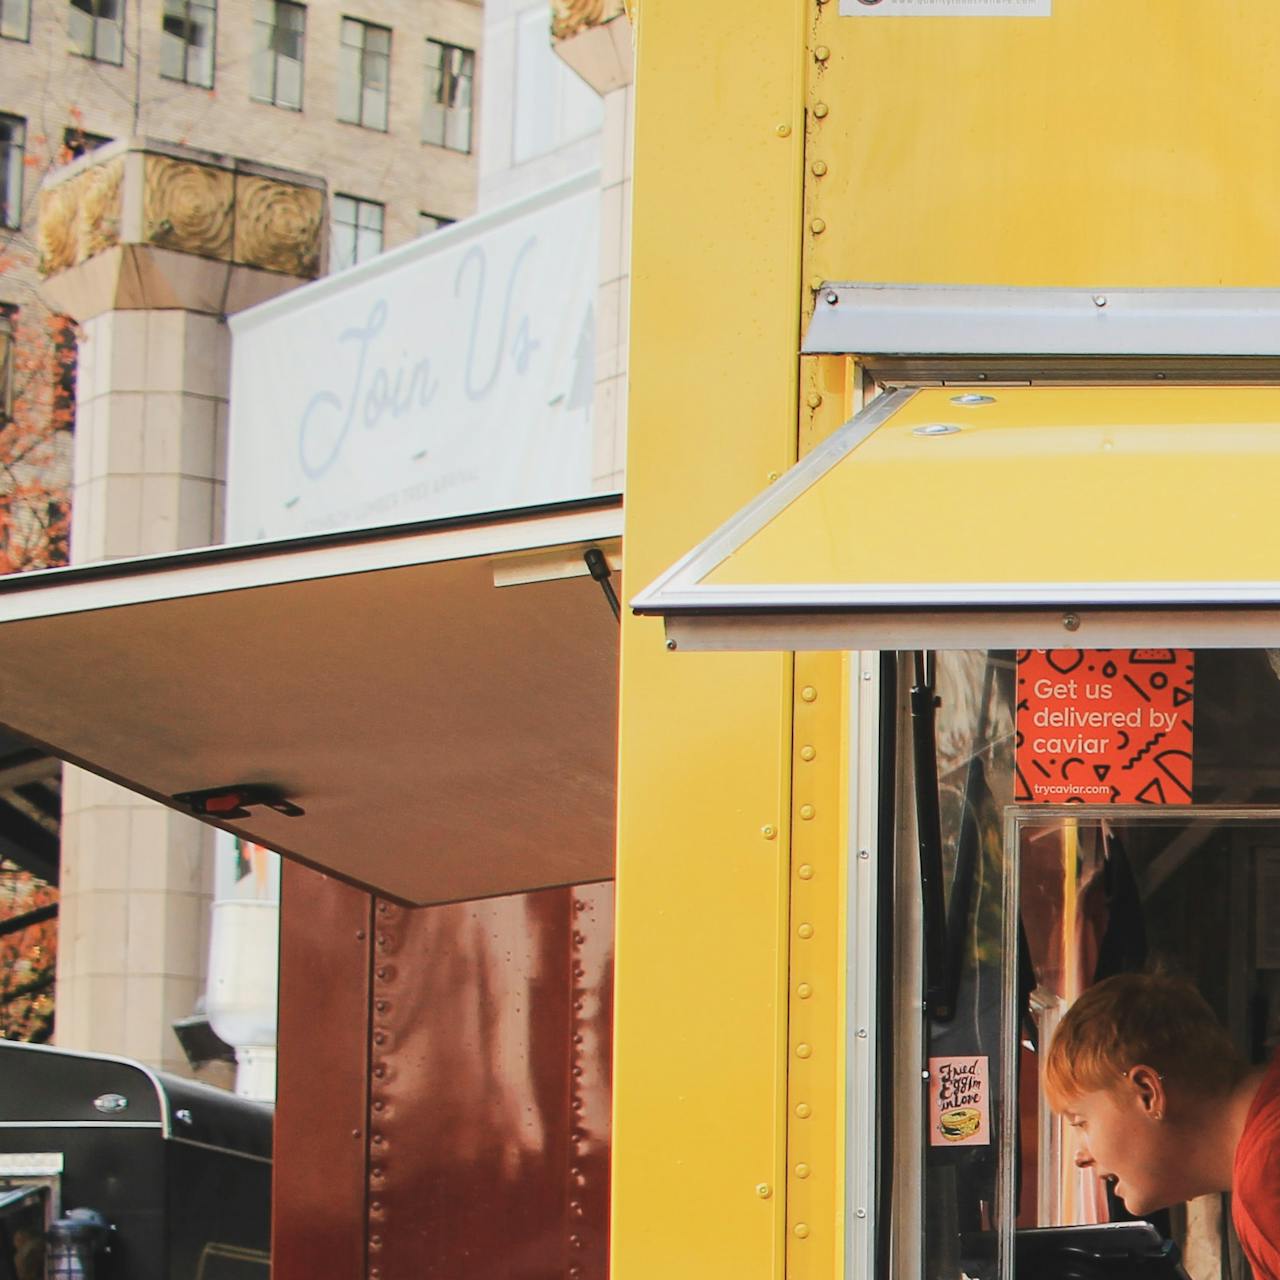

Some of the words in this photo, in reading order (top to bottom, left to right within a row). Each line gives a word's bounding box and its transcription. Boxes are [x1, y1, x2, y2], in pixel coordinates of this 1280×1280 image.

[298, 297, 439, 481] Join
[454, 233, 541, 403] Us
[1034, 679, 1077, 699] Get
[1085, 683, 1113, 699] us
[1033, 707, 1142, 728] delivered
[1150, 707, 1178, 732] by
[1033, 734, 1109, 754] caviar
[1034, 784, 1110, 796] trycaviar.com
[940, 1060, 979, 1082] Fried
[940, 1077, 969, 1100] Egg
[941, 1101, 954, 1111] in
[954, 1092, 980, 1108] Love
